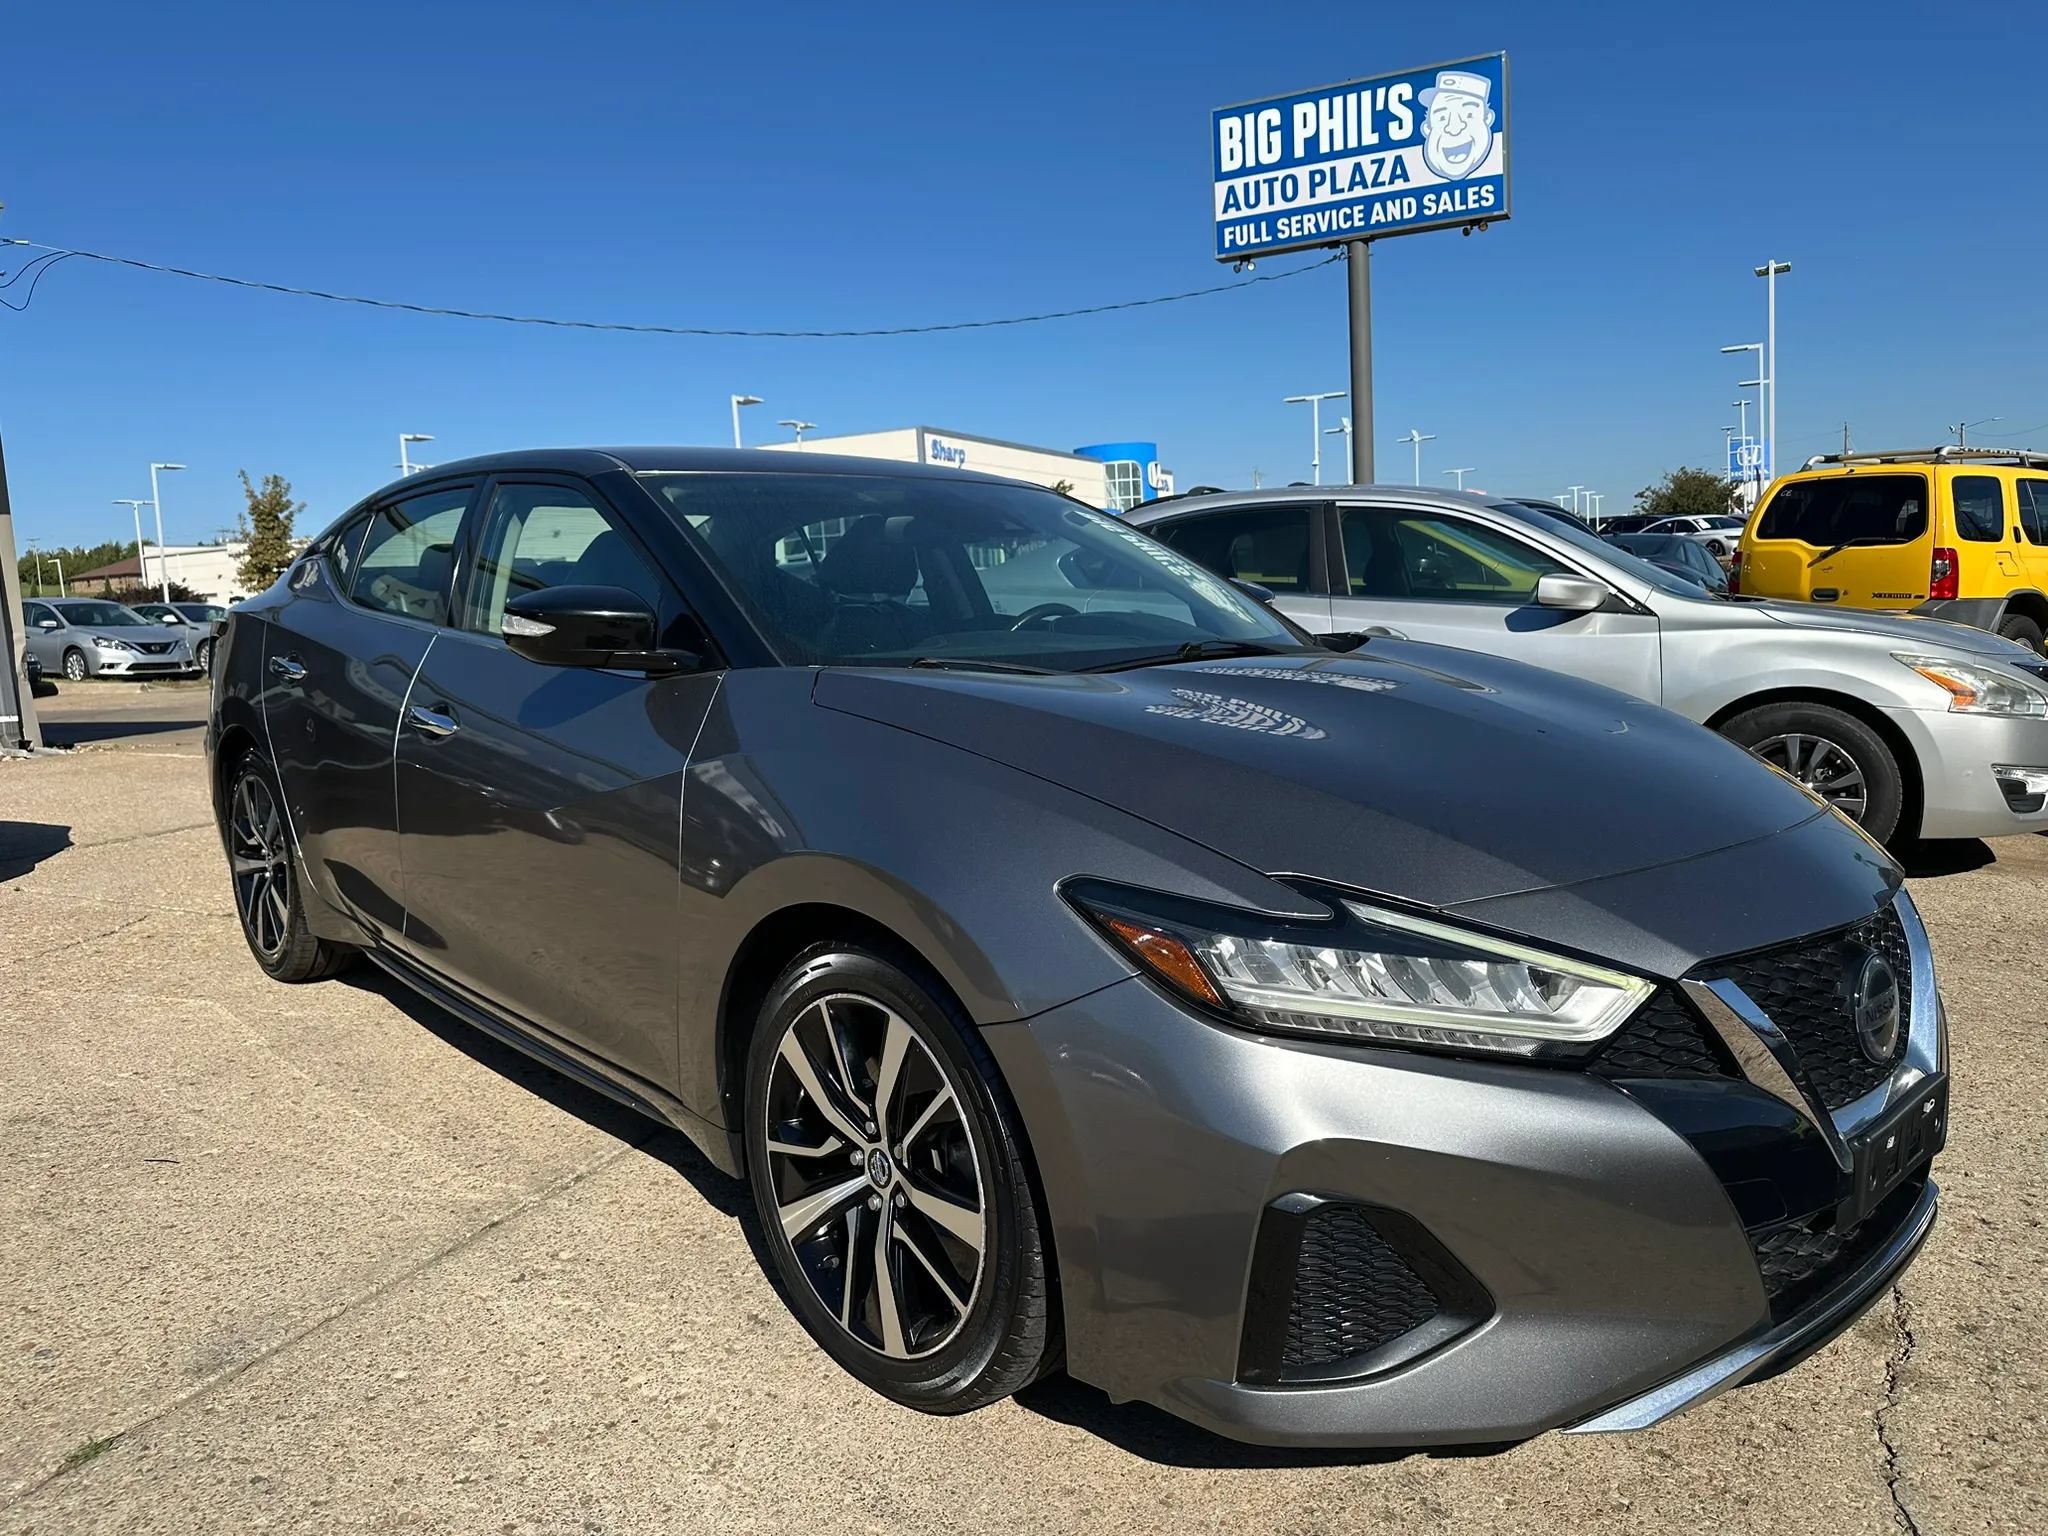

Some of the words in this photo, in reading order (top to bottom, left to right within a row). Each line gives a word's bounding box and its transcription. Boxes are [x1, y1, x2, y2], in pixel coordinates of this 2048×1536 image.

[1219, 107, 1282, 173] BIG
[1292, 82, 1413, 159] PHIL'S
[1221, 173, 1299, 215] AUTO
[1308, 154, 1410, 199] PLAZA
[1223, 221, 1272, 248] FULL
[1276, 207, 1364, 239] SERVICE
[1370, 199, 1417, 224] AND
[1422, 184, 1495, 216] SALES
[931, 439, 965, 469] Sharp
